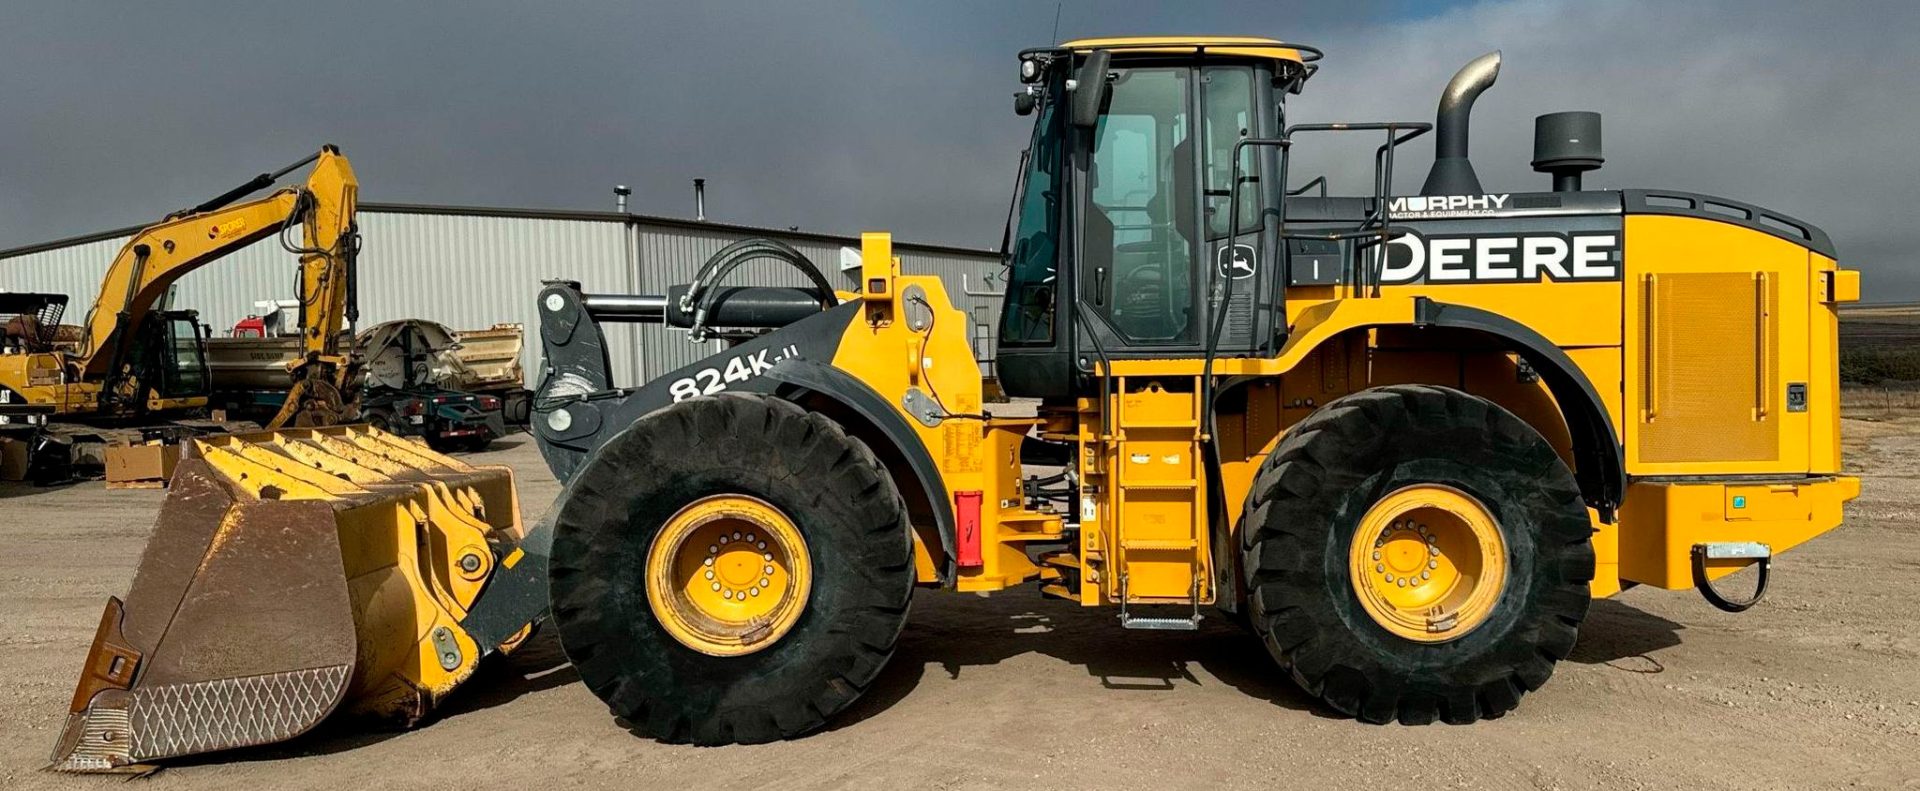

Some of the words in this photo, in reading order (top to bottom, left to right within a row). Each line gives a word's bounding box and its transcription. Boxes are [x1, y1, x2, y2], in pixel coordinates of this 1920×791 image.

[1381, 194, 1510, 211] MURPHY
[1431, 210, 1479, 218] EQUIPMENT
[1375, 233, 1616, 281] DEERE
